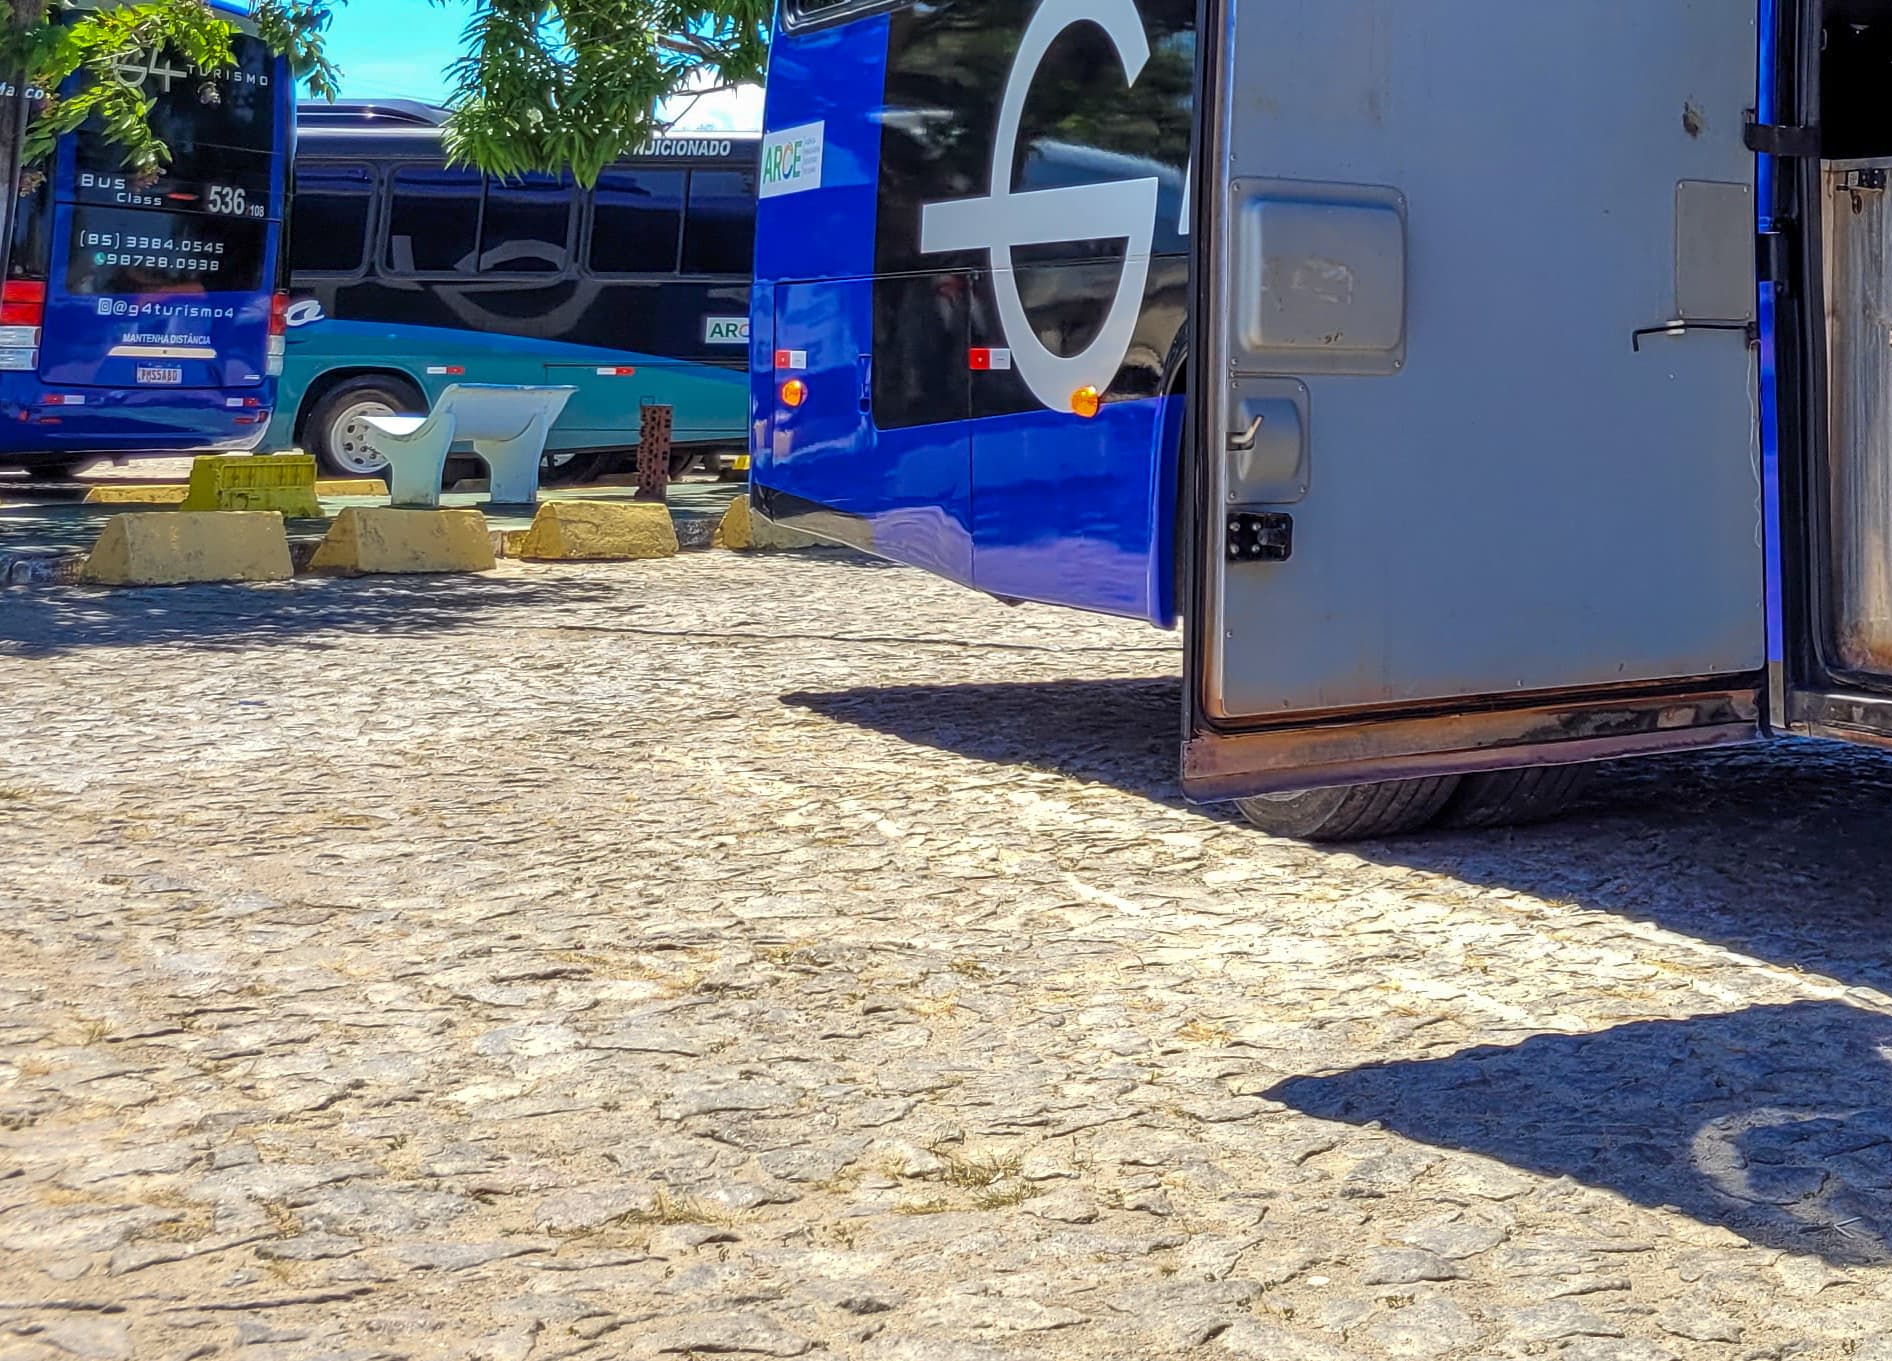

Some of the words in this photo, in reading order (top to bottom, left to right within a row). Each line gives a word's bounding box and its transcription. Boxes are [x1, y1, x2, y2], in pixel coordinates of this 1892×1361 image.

[186, 64, 269, 86] TURISMO
[763, 141, 802, 184] ARCE
[116, 192, 162, 206] Class
[208, 185, 245, 215] 536
[80, 230, 119, 249] (85)
[127, 236, 224, 254] 3384.0545
[107, 254, 219, 271] 98728.0938
[113, 300, 234, 318] @g4turismo4
[122, 333, 169, 343] MANTENHA
[170, 332, 211, 345] DISTÂNCIA
[709, 322, 749, 338] ARC
